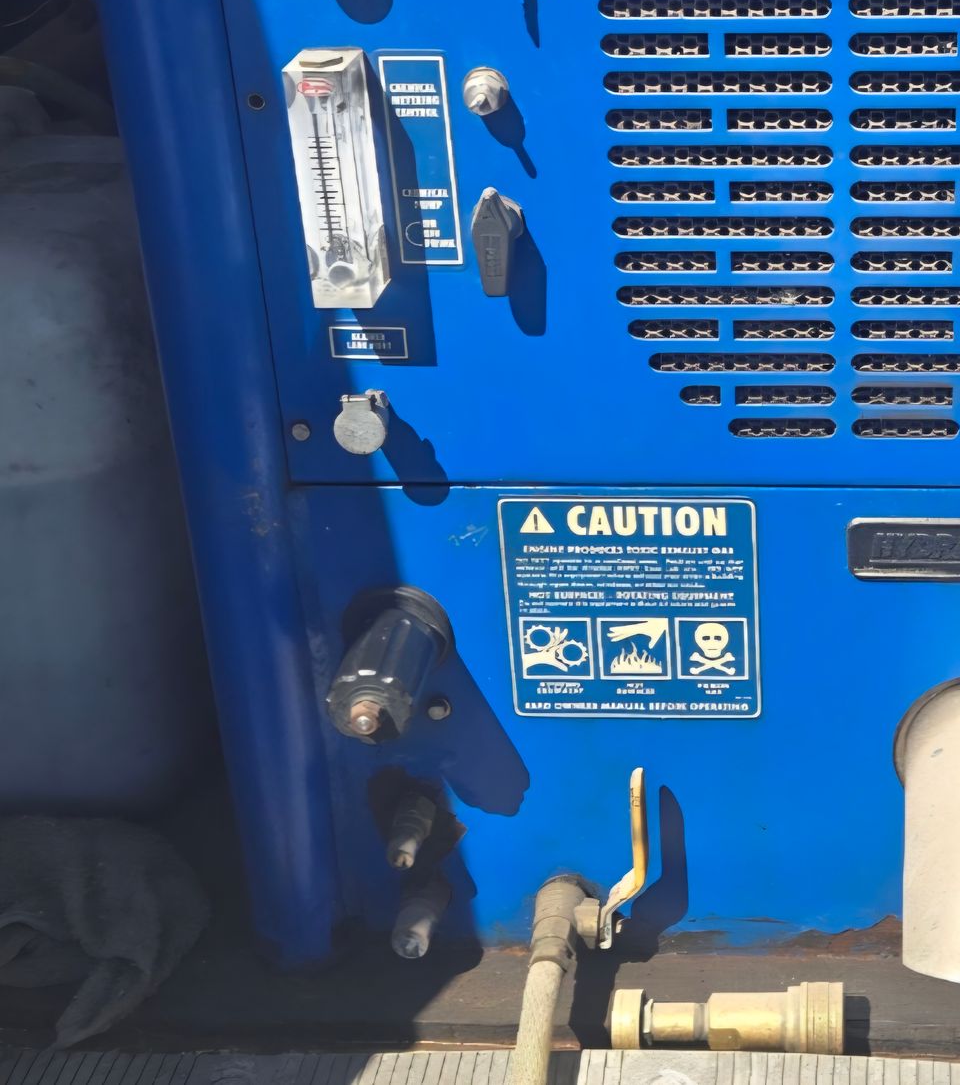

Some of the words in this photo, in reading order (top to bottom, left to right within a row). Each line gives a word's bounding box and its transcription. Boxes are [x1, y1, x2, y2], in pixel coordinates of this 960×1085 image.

[567, 505, 728, 536] CAUTION
[523, 545, 564, 555] ENGINE
[567, 545, 624, 555] PRODUCES
[627, 545, 659, 555] TOXIC
[661, 546, 709, 555] EXHAUST
[528, 591, 550, 599] HOT
[616, 592, 669, 600] ROTATING
[672, 592, 735, 601] EQUIPMENT
[525, 702, 551, 710] READ
[600, 702, 646, 711] MANUAL
[649, 702, 687, 711] BEFORE
[690, 702, 749, 711] OPERATING
